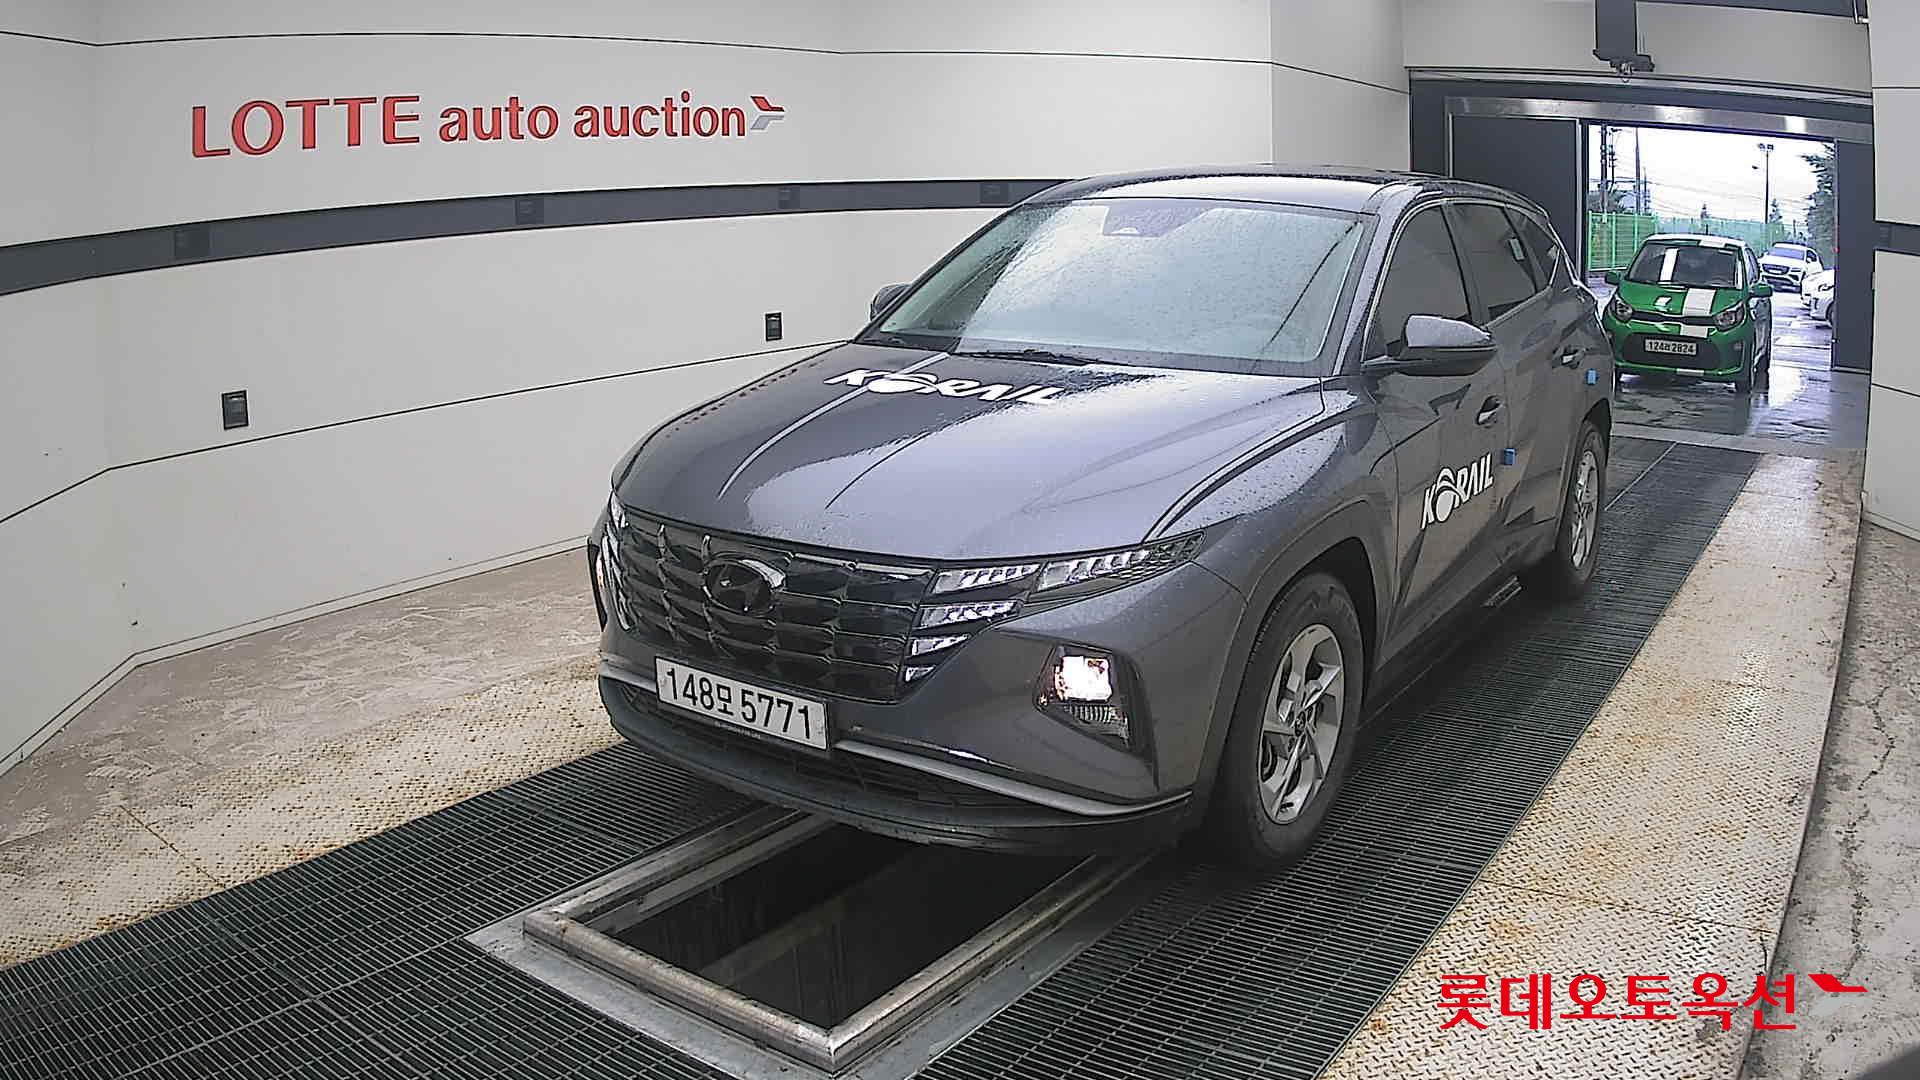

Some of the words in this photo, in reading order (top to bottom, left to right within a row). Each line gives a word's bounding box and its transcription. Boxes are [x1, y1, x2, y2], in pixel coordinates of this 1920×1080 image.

[191, 96, 420, 158] LOTTE
[438, 97, 559, 142] auto
[572, 91, 747, 138] auction
[1421, 452, 1494, 529] KORAIL
